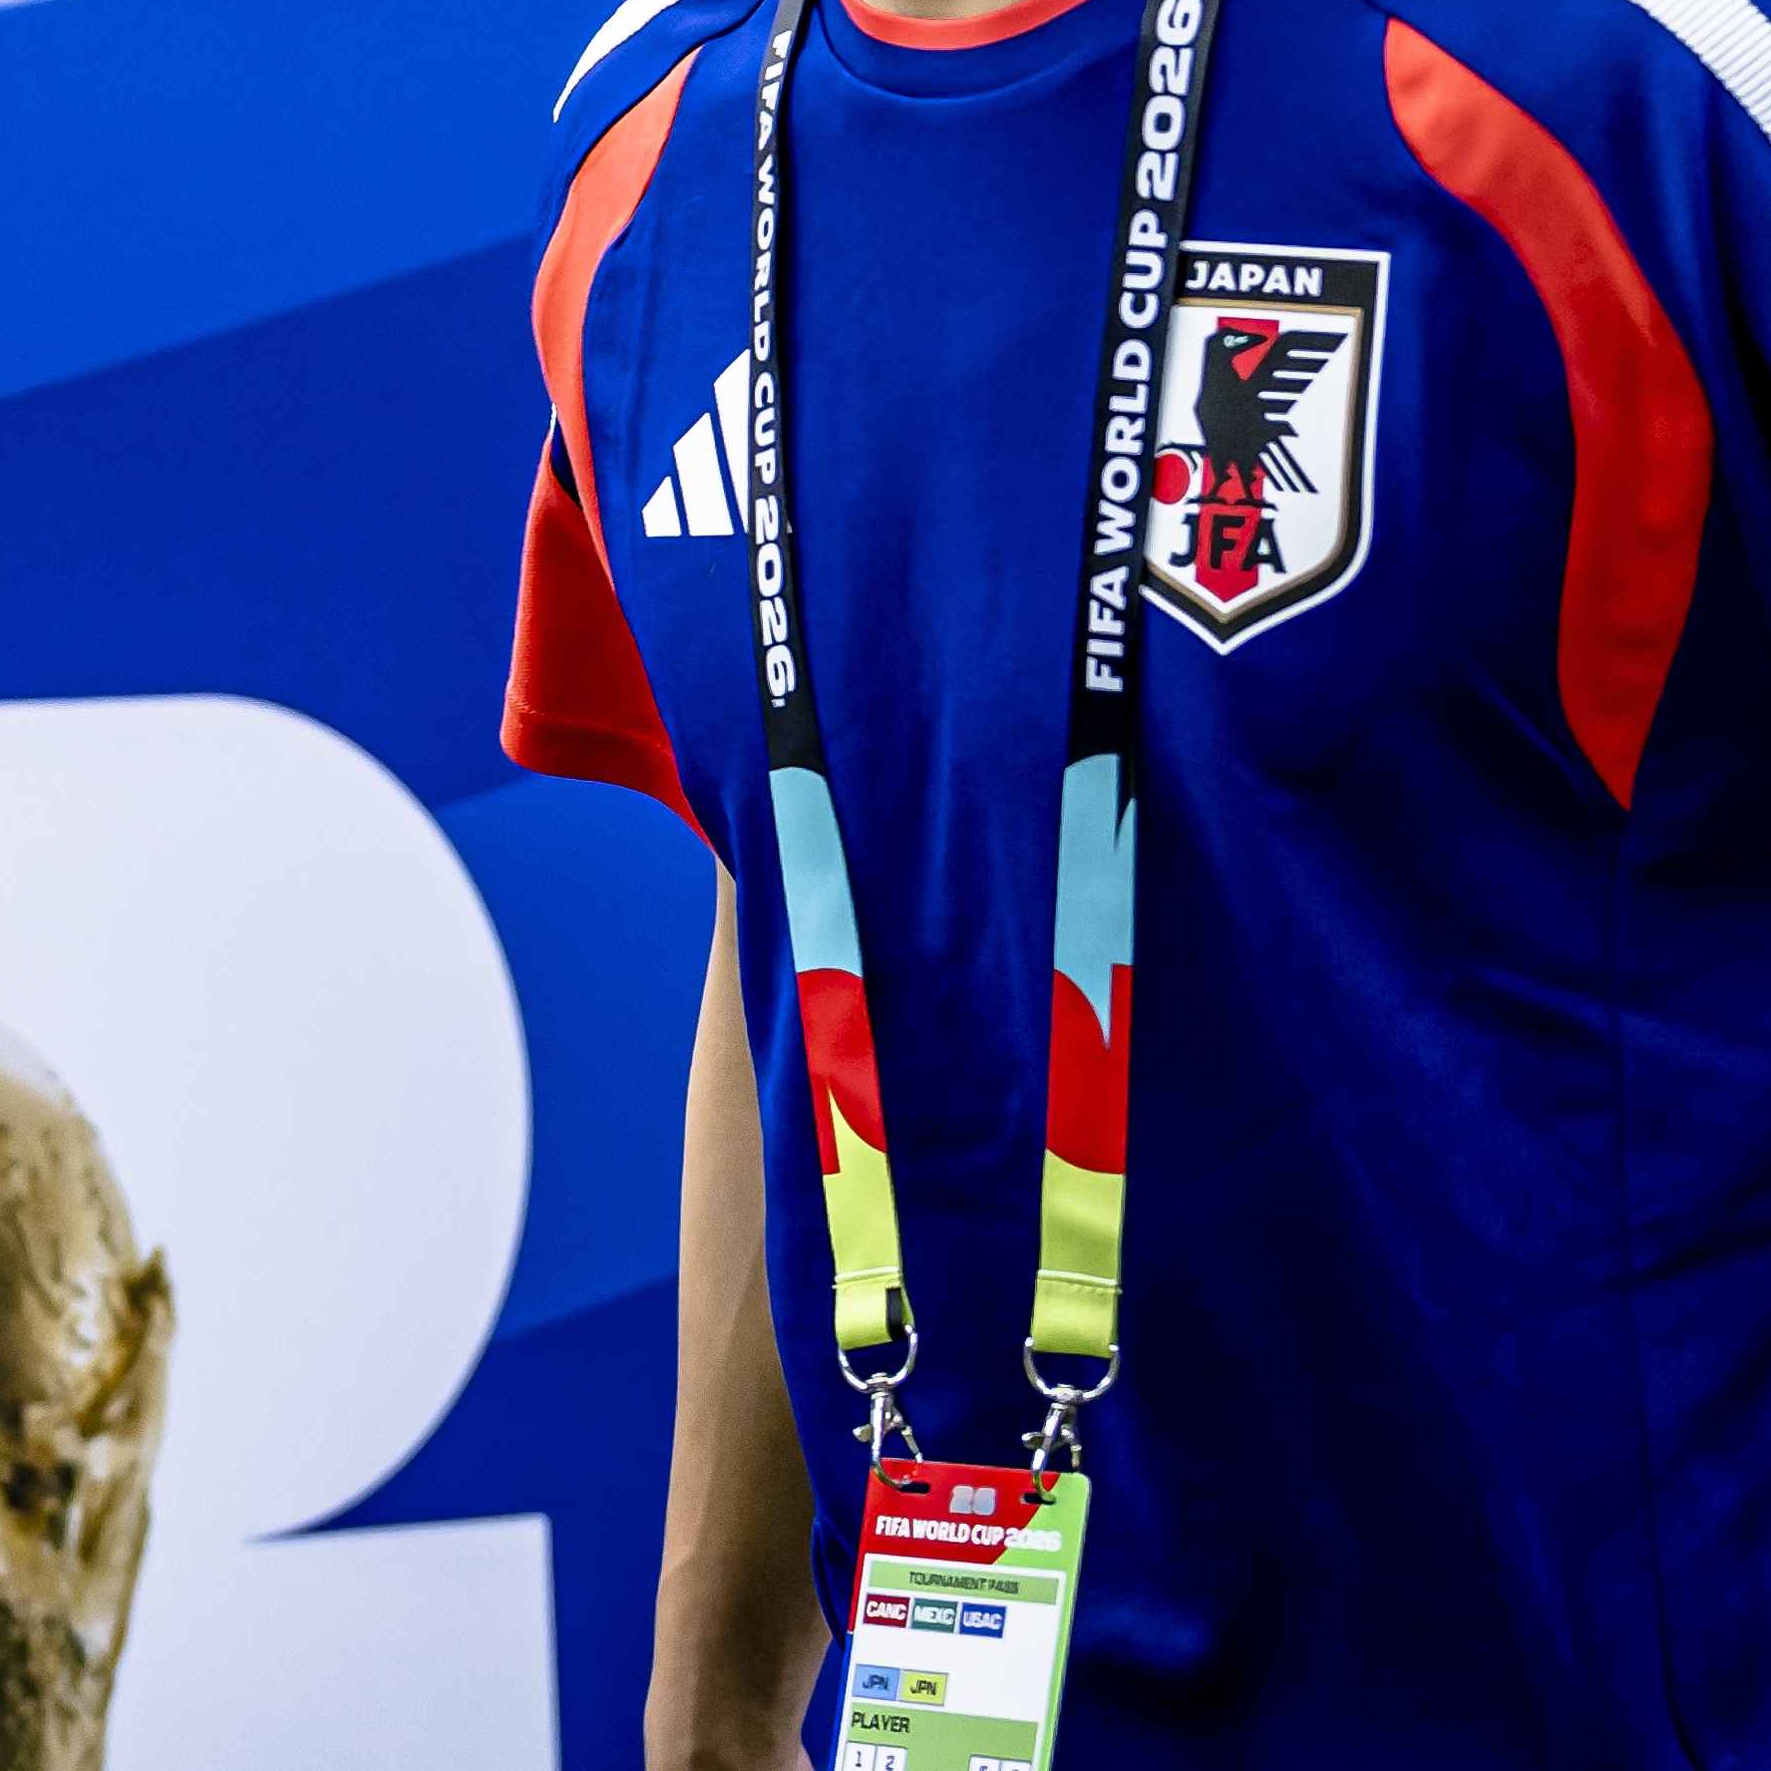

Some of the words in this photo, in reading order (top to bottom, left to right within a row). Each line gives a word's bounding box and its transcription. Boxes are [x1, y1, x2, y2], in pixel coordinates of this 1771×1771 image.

[758, 29, 792, 152] FIFA
[754, 154, 776, 363] WORLD
[1117, 208, 1169, 330] CUP
[1185, 259, 1324, 297] JAPAN
[754, 370, 777, 485] CUP
[1094, 338, 1153, 556] WORLD
[1167, 513, 1287, 574] JFA
[1085, 566, 1129, 692] FIFA
[875, 1515, 911, 1539] FIFA
[912, 1519, 971, 1544] WORLD
[971, 1524, 1004, 1547] CUP
[1004, 1528, 1063, 1553] 2026
[909, 1570, 987, 1591] TOURNAMENT
[862, 1674, 889, 1691] JPN
[909, 1679, 938, 1696] JPN
[851, 1711, 910, 1733] PLAYER
[854, 1750, 863, 1768] 1
